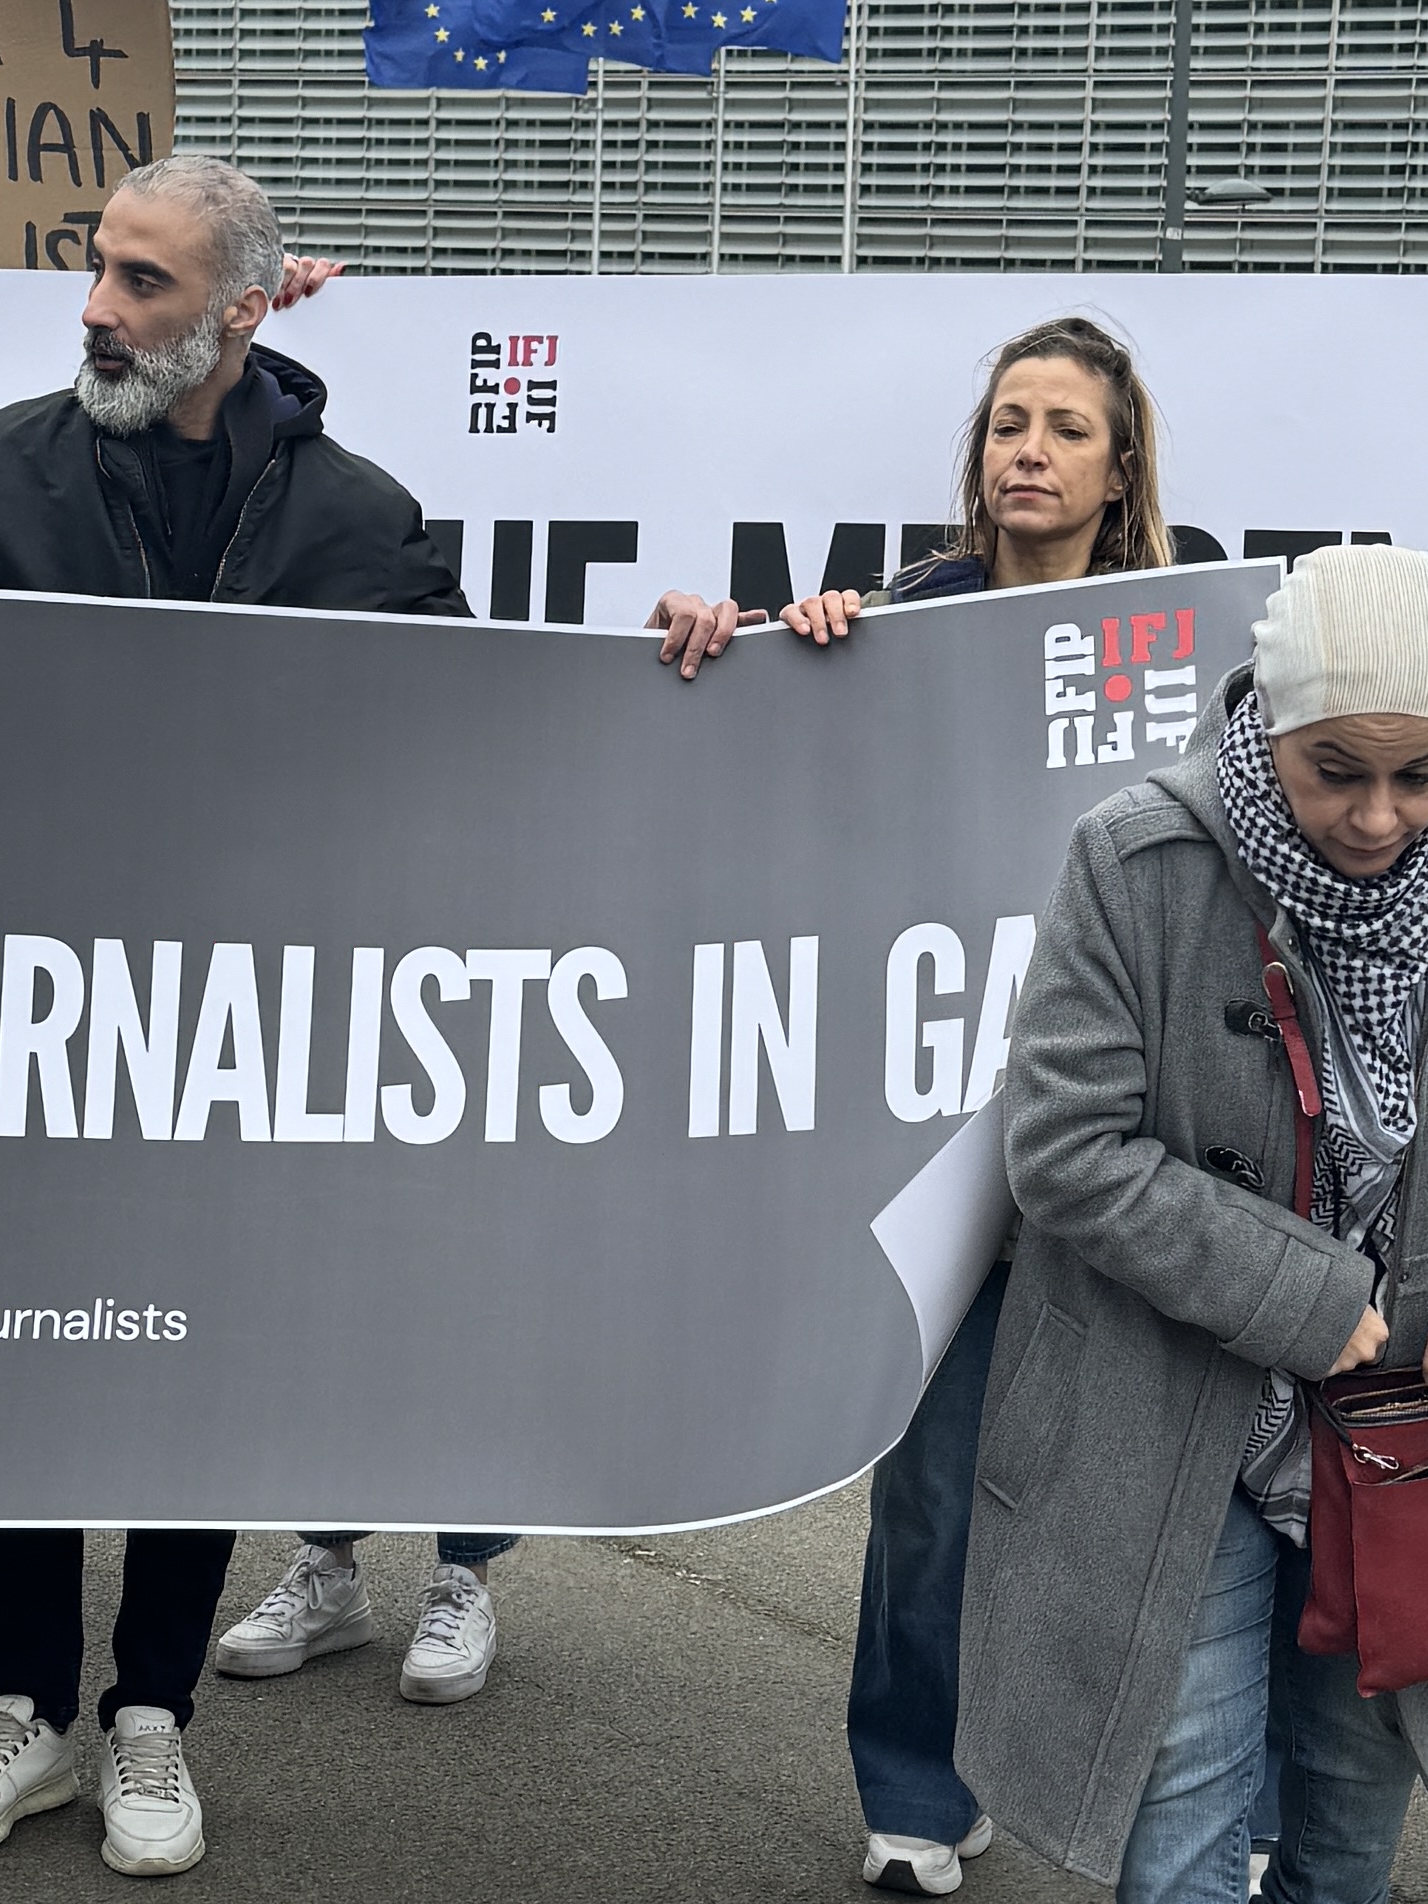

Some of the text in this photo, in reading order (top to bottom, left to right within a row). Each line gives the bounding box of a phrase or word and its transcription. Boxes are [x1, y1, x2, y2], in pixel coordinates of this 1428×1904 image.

[508, 335, 559, 366] IFJ
[1101, 608, 1195, 668] IFJ
[687, 935, 819, 1138] IN
[885, 914, 1037, 1123] GA
